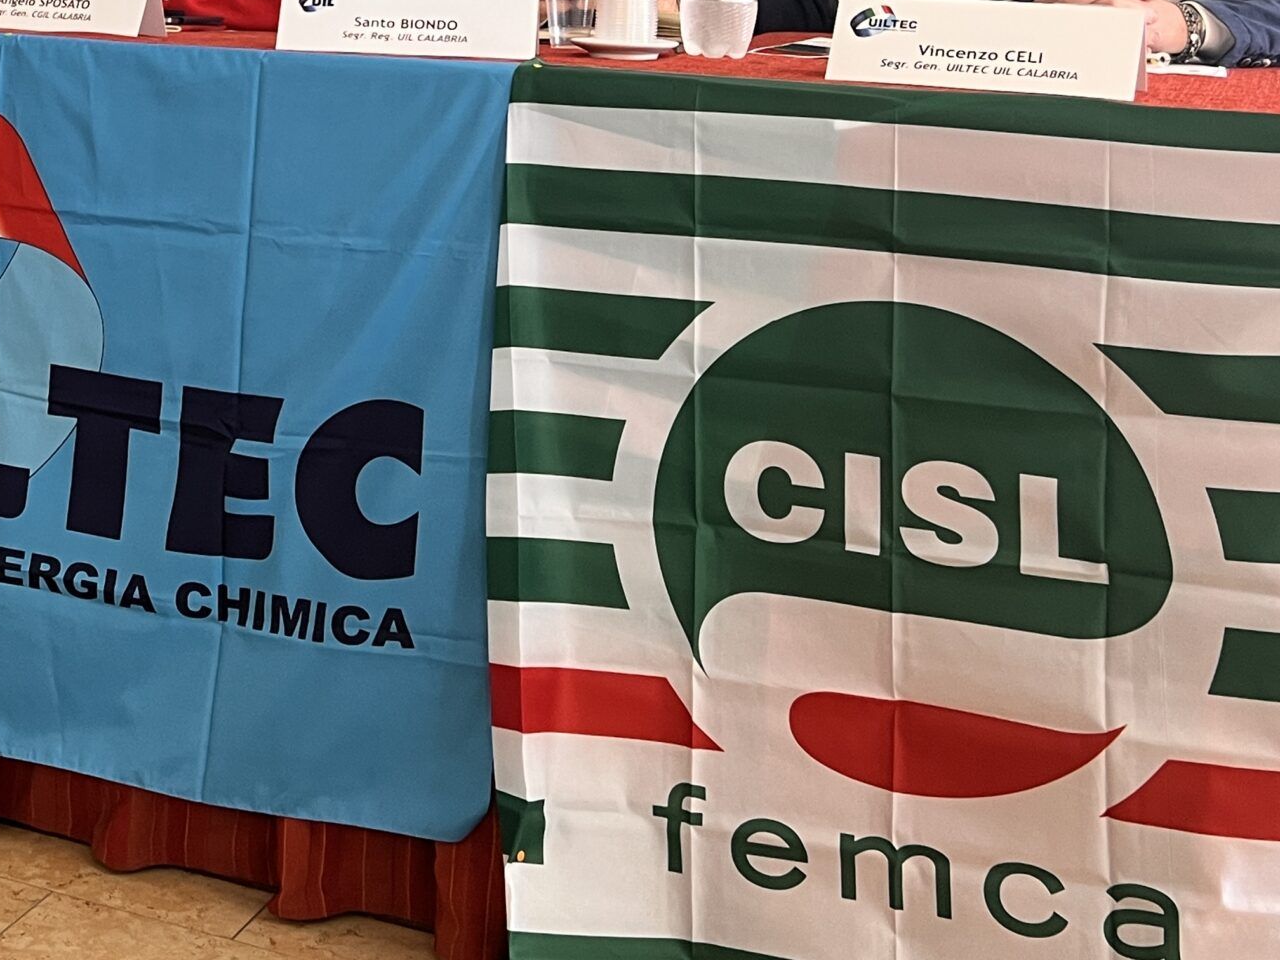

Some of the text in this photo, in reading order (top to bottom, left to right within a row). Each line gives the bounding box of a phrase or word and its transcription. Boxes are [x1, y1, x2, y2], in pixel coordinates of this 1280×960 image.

[31, 10, 50, 19] CGIL
[52, 12, 92, 21] CALABRIA
[354, 16, 458, 31] Santo BIONDO
[869, 18, 918, 30] UILTEC
[342, 31, 468, 43] Segr. Reg. UIL CALABRIA
[918, 44, 1043, 64] Vincenzo CELI
[880, 58, 1079, 81] Segr. Gen. UILTEC UIL CALABRIA
[723, 440, 1110, 585] CISL
[175, 580, 415, 650] CHIMICA
[652, 782, 1180, 960] femca
